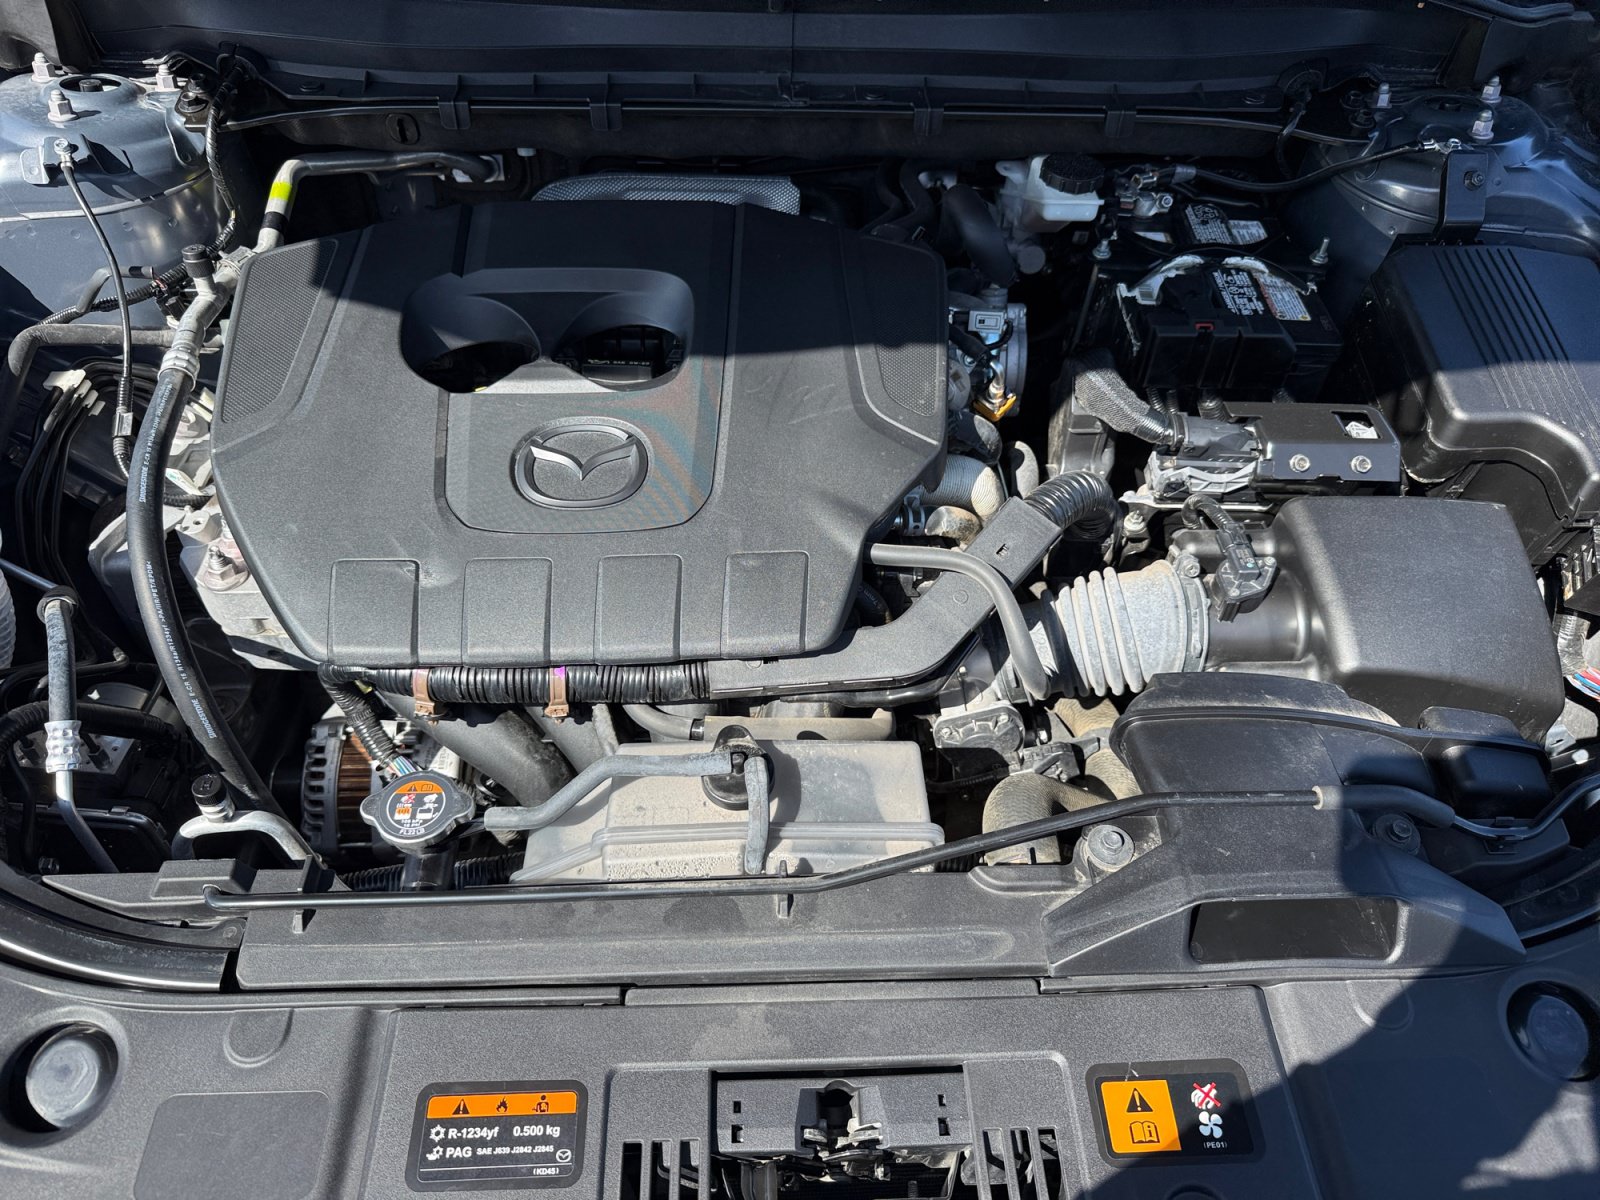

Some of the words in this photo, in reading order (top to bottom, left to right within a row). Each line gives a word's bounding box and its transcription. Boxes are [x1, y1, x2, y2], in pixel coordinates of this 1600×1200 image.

[191, 698, 218, 739] BRIDGESTONE
[448, 1127, 500, 1140] R-1234yf
[513, 1125, 544, 1137] 0.500
[545, 1125, 561, 1137] kg
[445, 1147, 472, 1158] PAG
[476, 1147, 492, 1156] SAE
[511, 1146, 532, 1154] J2842
[533, 1145, 554, 1153] J2845
[532, 1167, 559, 1176] (KD45)
